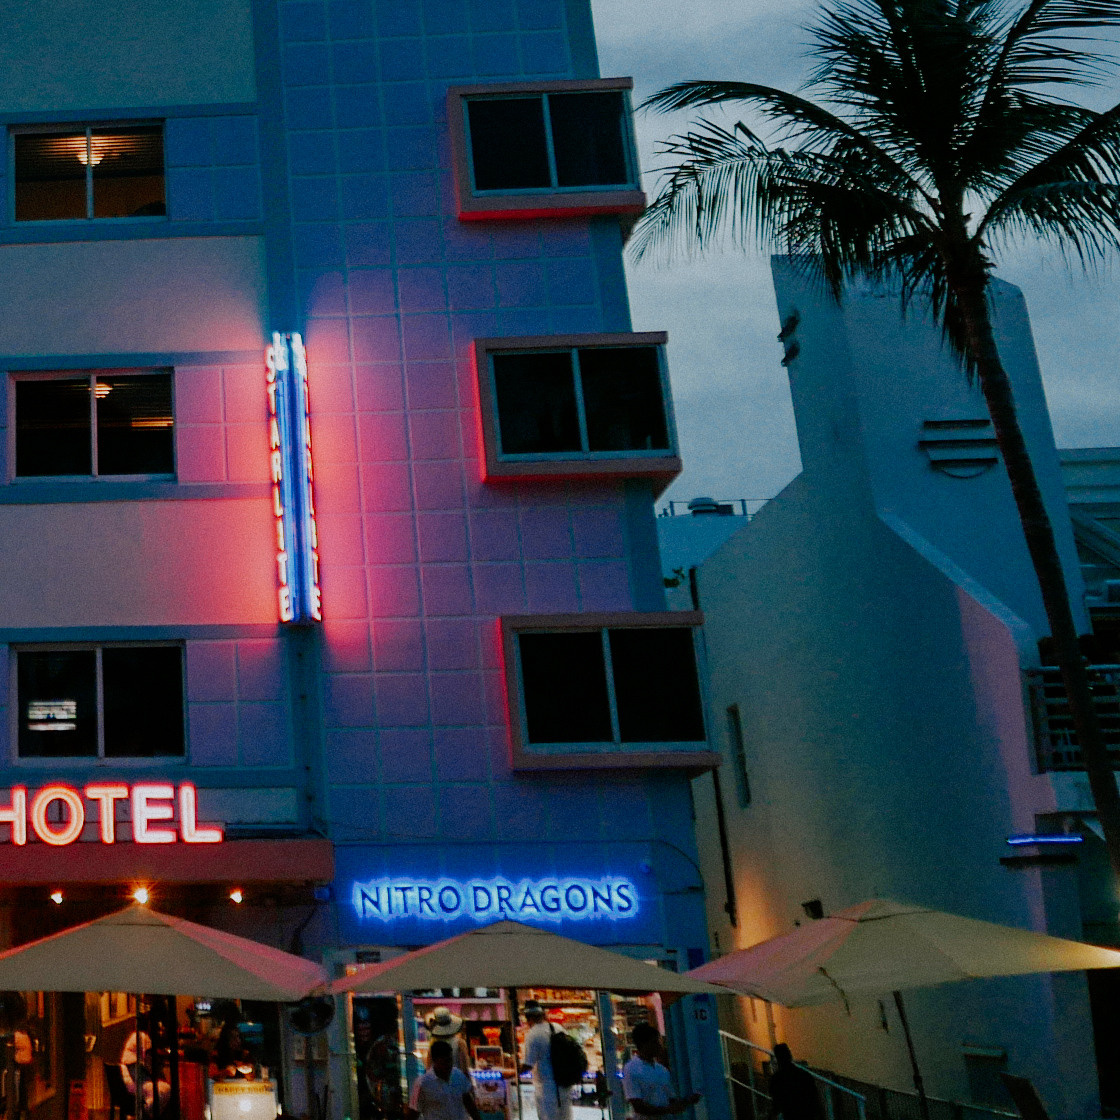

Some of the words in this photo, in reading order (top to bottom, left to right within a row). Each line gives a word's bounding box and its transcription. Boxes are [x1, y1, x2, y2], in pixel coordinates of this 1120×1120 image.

[265, 345, 291, 622] STARLITE
[359, 884, 460, 914] NITRO
[472, 883, 632, 913] DRAGONS
